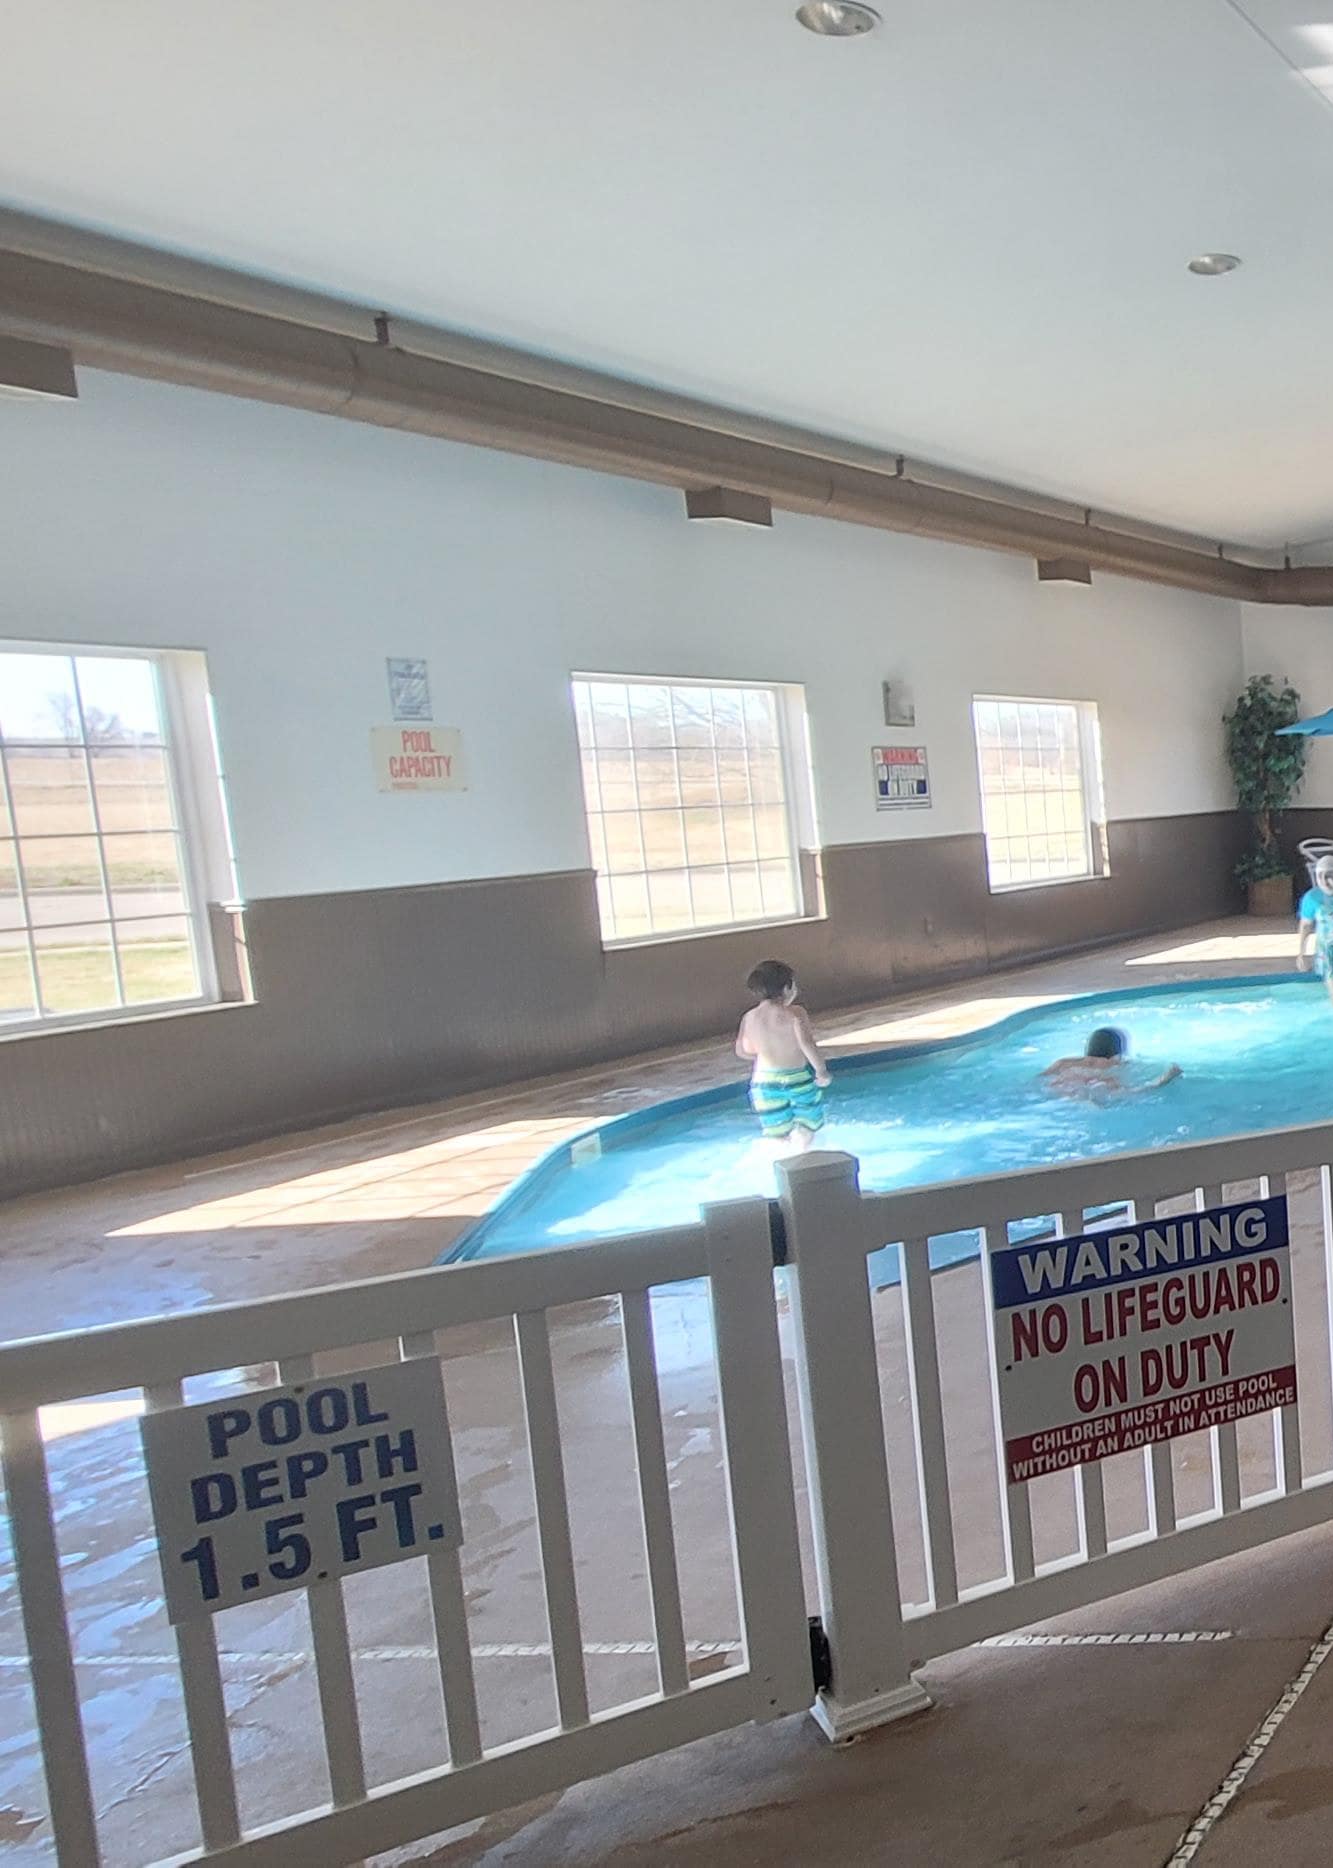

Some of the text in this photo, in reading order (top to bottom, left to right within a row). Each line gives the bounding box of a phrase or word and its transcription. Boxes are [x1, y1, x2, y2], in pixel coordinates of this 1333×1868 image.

[389, 755, 452, 778] CAPACITY
[401, 730, 435, 752] POOL
[1018, 1208, 1268, 1294] WARNING
[1012, 1257, 1280, 1361] NO LIFEGUARD
[1032, 1373, 1278, 1453] CHILDREN MUST NOT USE POOL
[1074, 1329, 1236, 1413] ON DUTY
[206, 1381, 389, 1458] POOL
[1012, 1386, 1294, 1480] WITHOUT AN ADULT IN ATTENDANCE
[190, 1428, 419, 1524] DEPTH
[181, 1482, 445, 1601] 1.5 FT.
